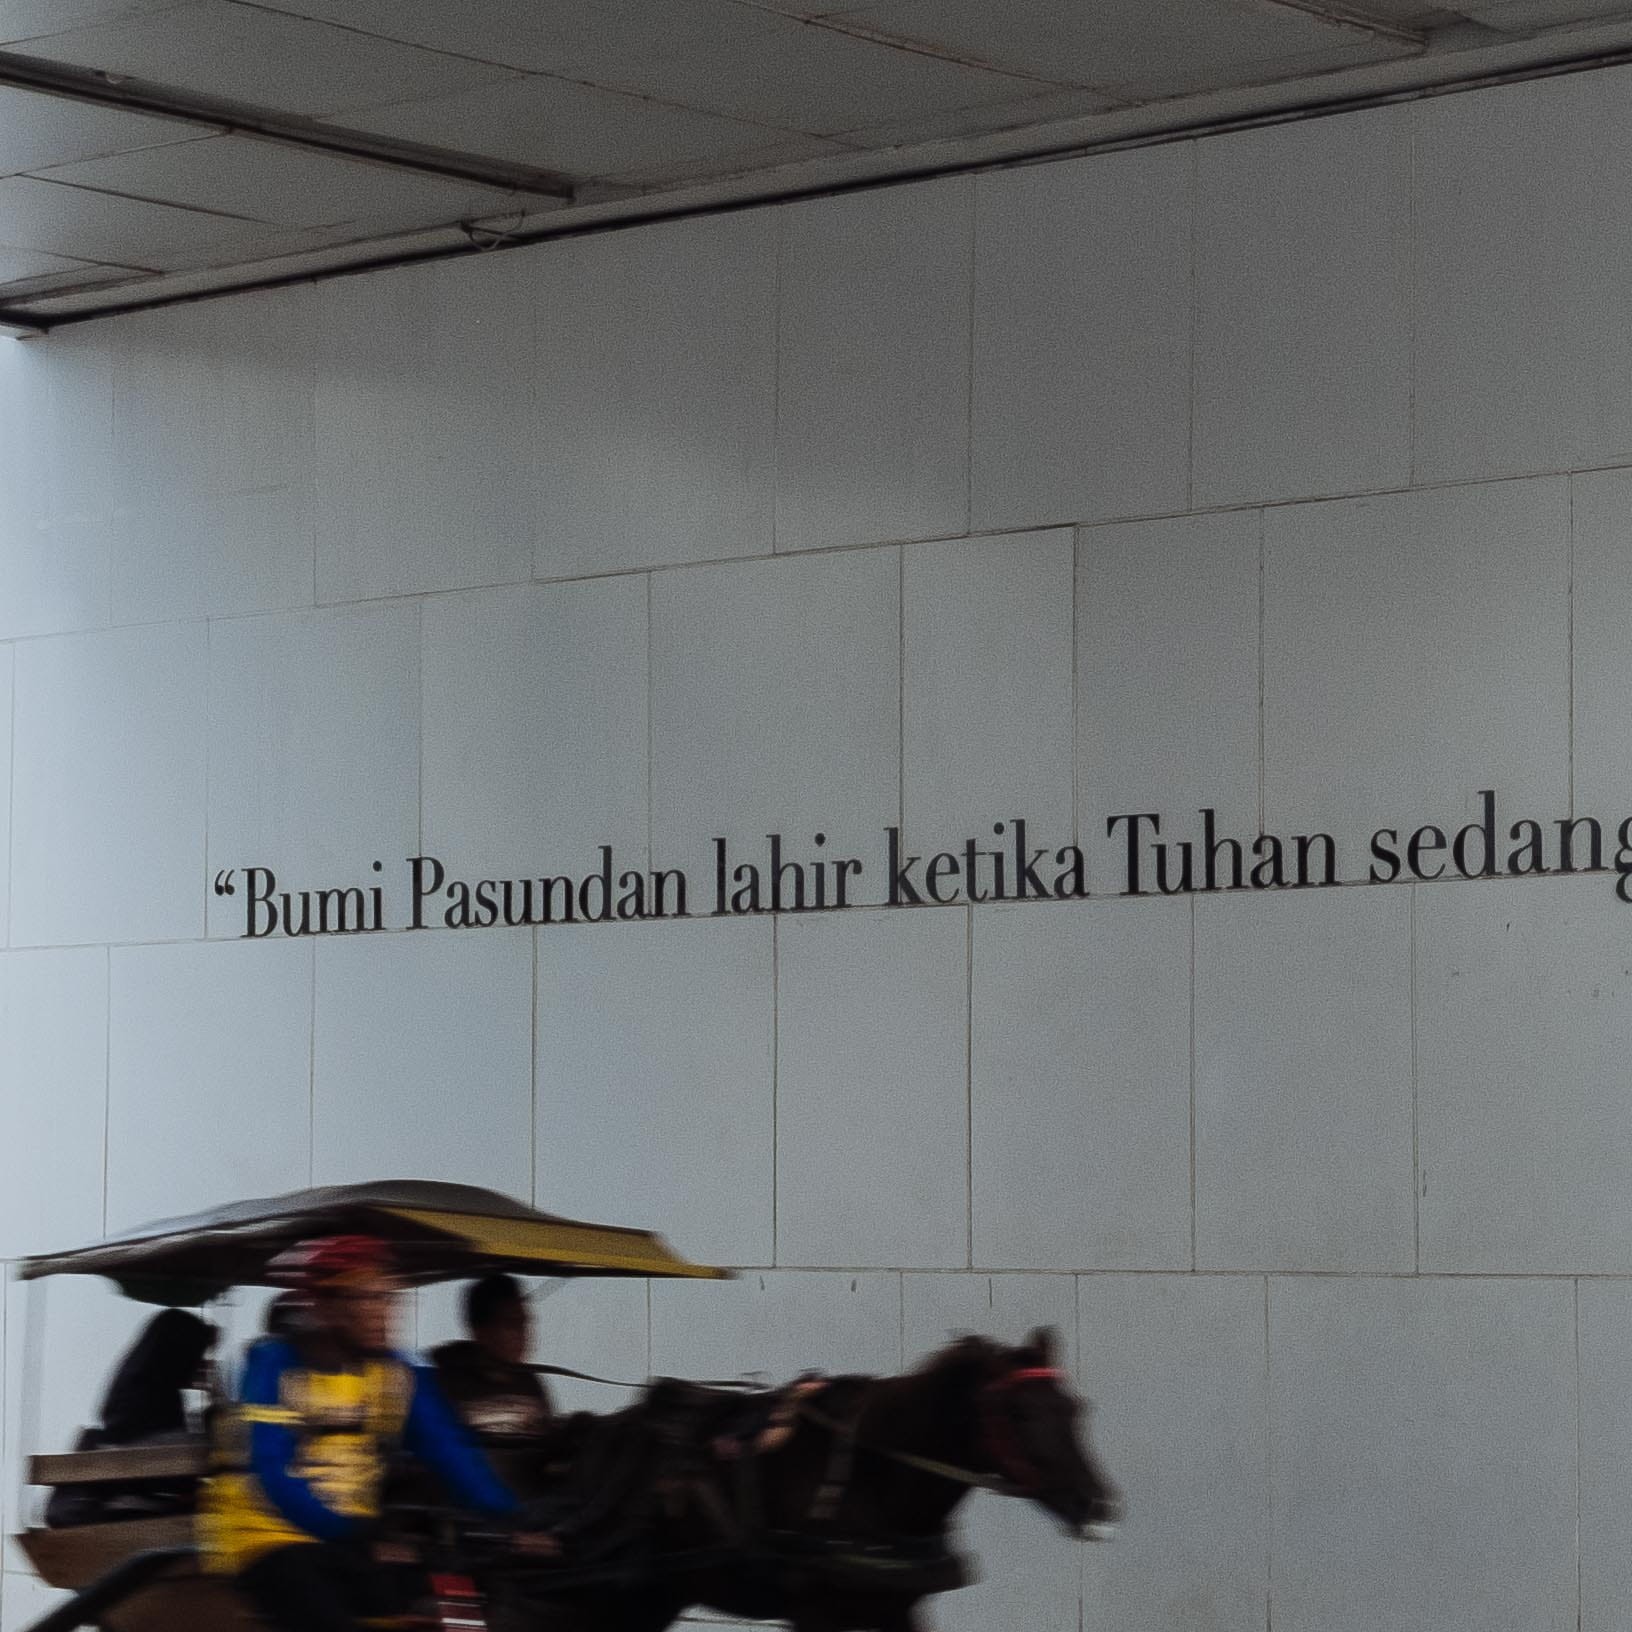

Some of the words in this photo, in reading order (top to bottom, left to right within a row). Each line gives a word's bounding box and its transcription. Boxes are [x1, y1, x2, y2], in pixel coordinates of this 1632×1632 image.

[406, 844, 689, 932] Pasundan
[712, 831, 863, 917] lahir
[883, 819, 1090, 907] ketika
[1107, 808, 1342, 894] Tuhan
